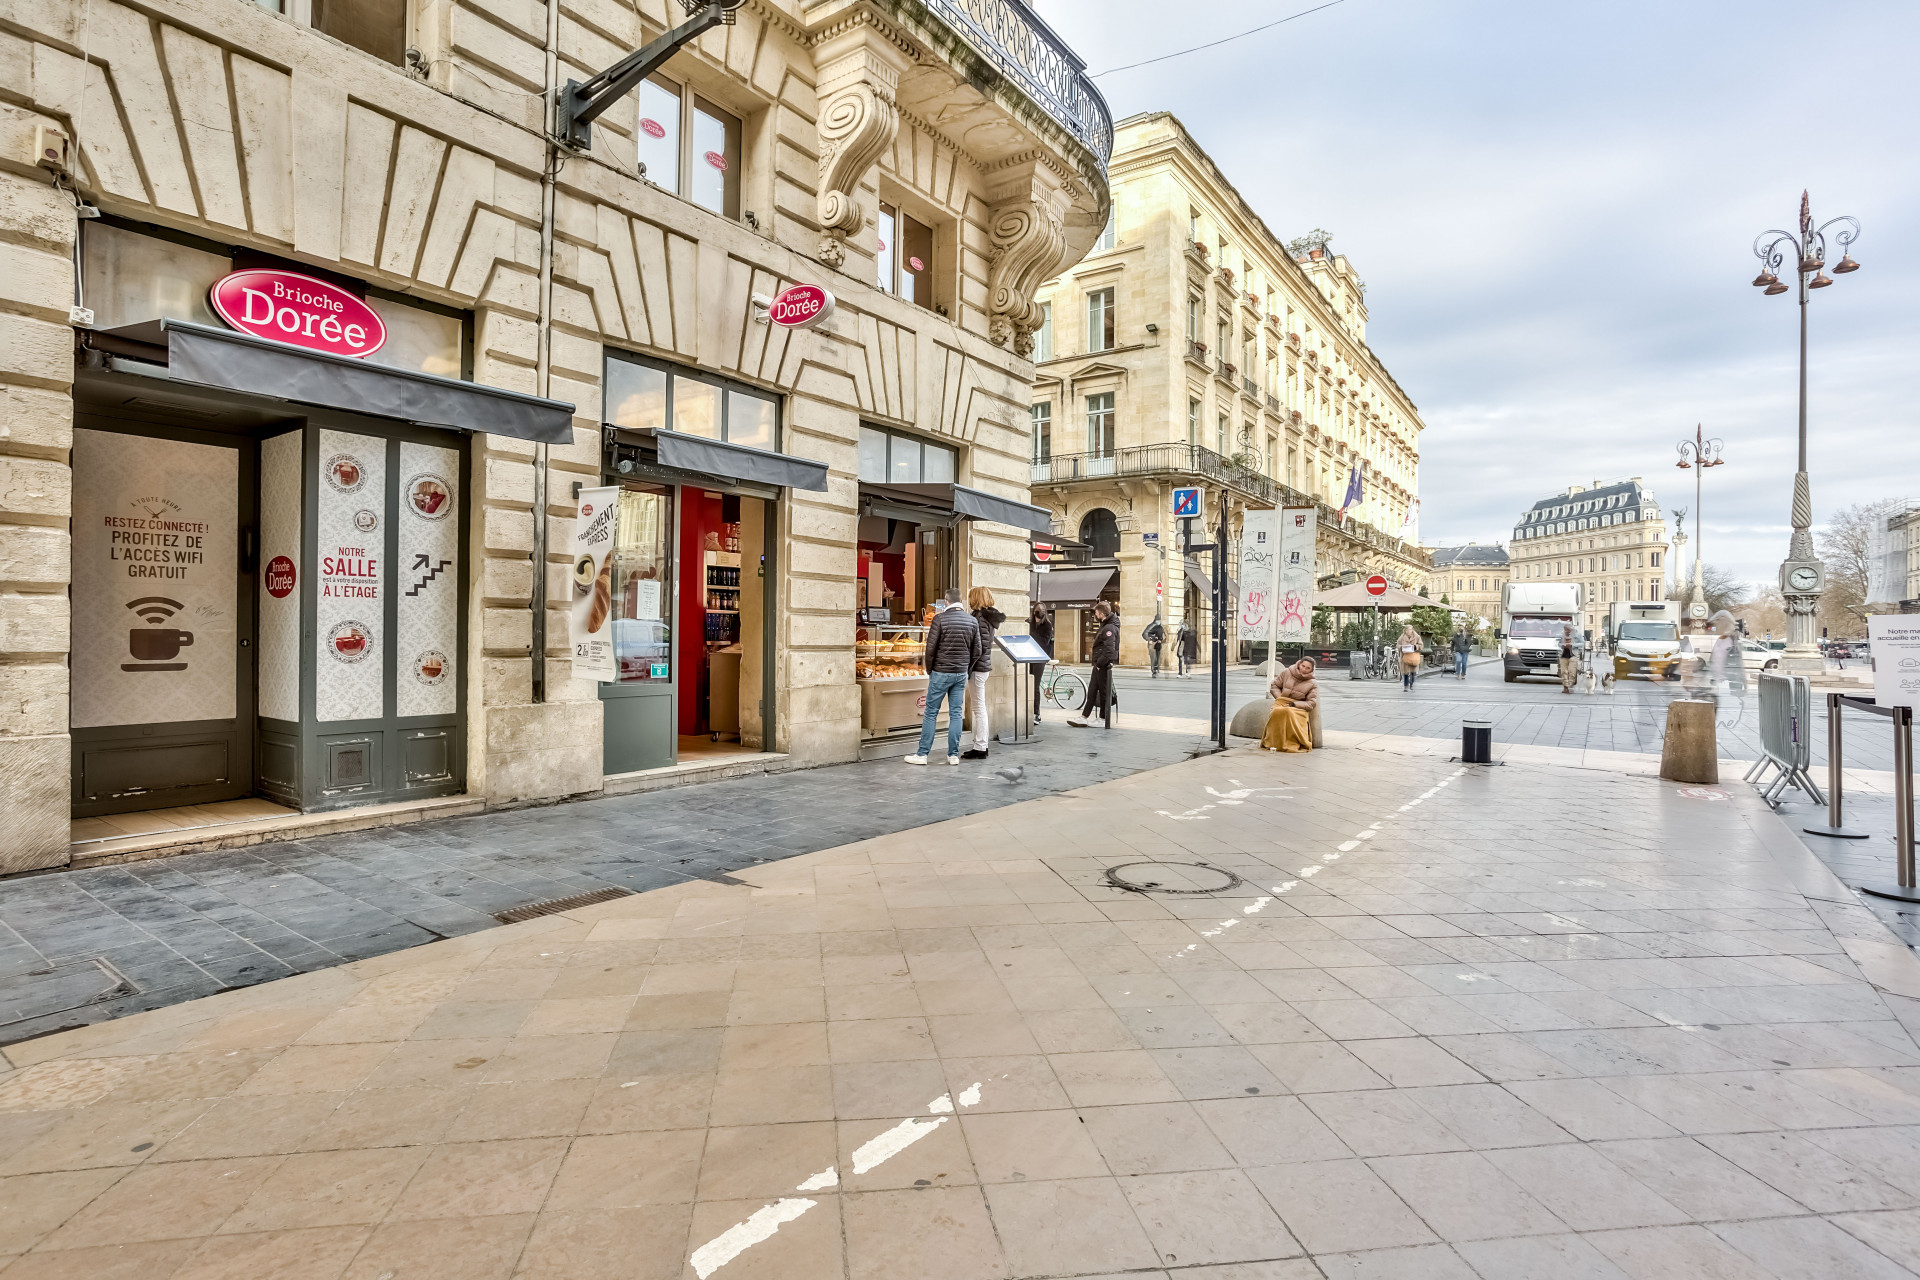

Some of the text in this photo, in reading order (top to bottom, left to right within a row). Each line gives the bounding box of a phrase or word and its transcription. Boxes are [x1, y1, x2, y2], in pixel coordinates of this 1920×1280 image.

[273, 281, 344, 312] Brioche
[786, 291, 810, 302] Brioche
[241, 287, 366, 348] Dorée
[776, 299, 818, 319] Dorée
[162, 498, 182, 512] HEURE
[104, 517, 145, 529] RESTEZ
[149, 520, 203, 533] CONNECTÉ
[578, 503, 614, 541] FRANCHEMENT
[112, 531, 202, 548] PROFITEZ DE
[588, 526, 608, 546] EXPRESS
[111, 547, 202, 564] L'ACCÈS WIFI
[339, 547, 365, 557] NOTRE
[128, 565, 187, 579] GRATUIT
[272, 561, 290, 572] Brioche
[323, 557, 376, 577] SALLE
[269, 573, 292, 590] Dorée
[324, 583, 377, 598] À L'ÉTAGE
